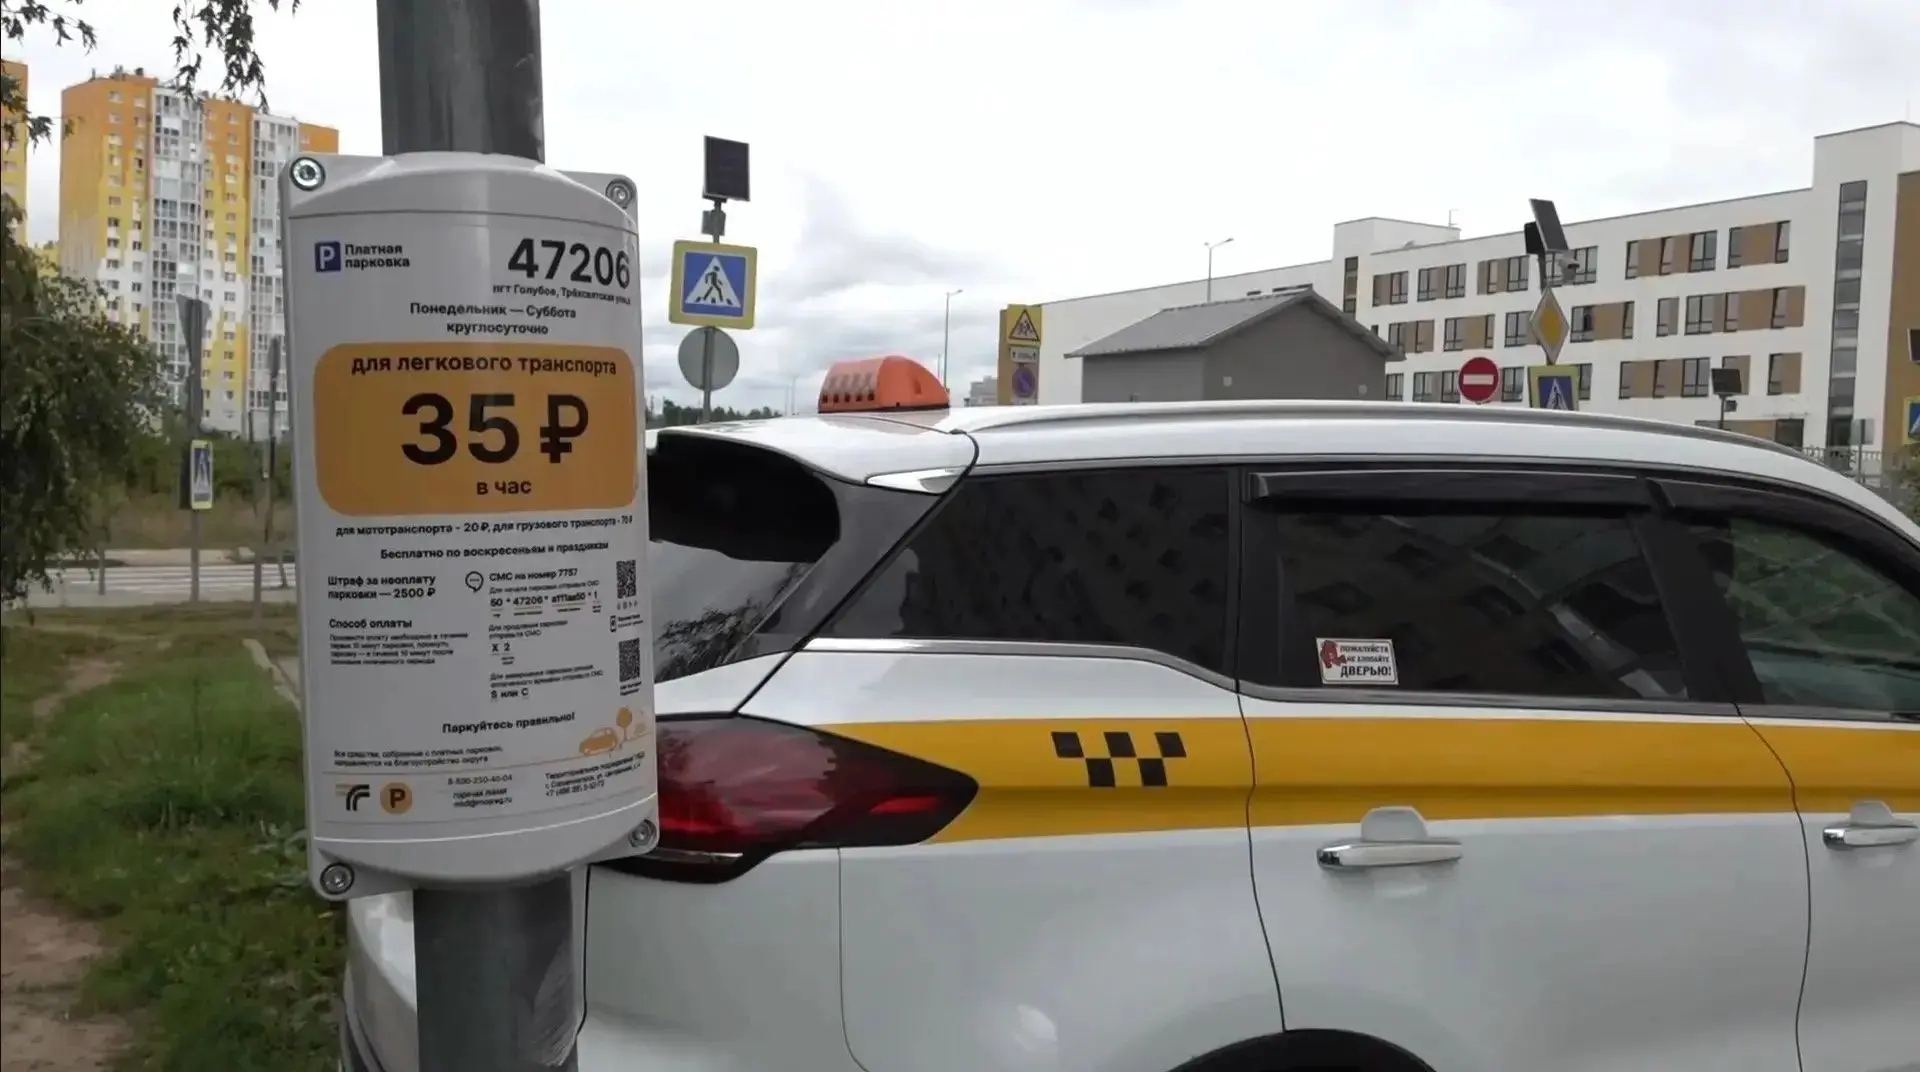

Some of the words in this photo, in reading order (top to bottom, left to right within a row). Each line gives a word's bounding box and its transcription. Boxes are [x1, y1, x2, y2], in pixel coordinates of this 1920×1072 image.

[345, 244, 402, 255] Платная
[345, 257, 410, 270] парковка
[508, 238, 630, 289] 47206
[493, 285, 511, 294] пгт
[410, 302, 506, 316] Понедельник
[526, 305, 576, 319] Суббота
[447, 322, 549, 336] круглосуточно
[351, 357, 391, 375] для
[397, 356, 512, 372] легкового
[520, 356, 616, 377] транспорта
[401, 393, 520, 465] 35
[476, 481, 489, 495] в
[494, 480, 532, 495] час
[336, 527, 355, 537] для
[357, 524, 453, 536] мототранспорта
[493, 522, 514, 533] для
[516, 519, 568, 531] грузового
[571, 517, 616, 529] транспорта
[381, 549, 444, 560] Бесплатно
[446, 548, 461, 558] по
[464, 545, 546, 558] воскресеньям
[548, 545, 554, 553] и
[556, 541, 609, 553] праздникам
[328, 576, 365, 588] Штраф
[367, 577, 378, 586] за
[381, 575, 436, 587] неоплату
[489, 573, 513, 582] СМС
[527, 571, 557, 581] номер
[558, 568, 578, 578] 7757
[328, 590, 377, 601] парковки
[393, 588, 424, 599] 2500
[513, 596, 543, 605] 47206
[329, 618, 368, 629] Способ
[369, 619, 413, 629] оплаты
[1340, 645, 1389, 653] ПОЖАЛУЙСТА
[1340, 665, 1392, 678] ДВЕРЬЮ!
[442, 721, 514, 734] Паркуйтесь
[516, 712, 575, 729] правильно!
